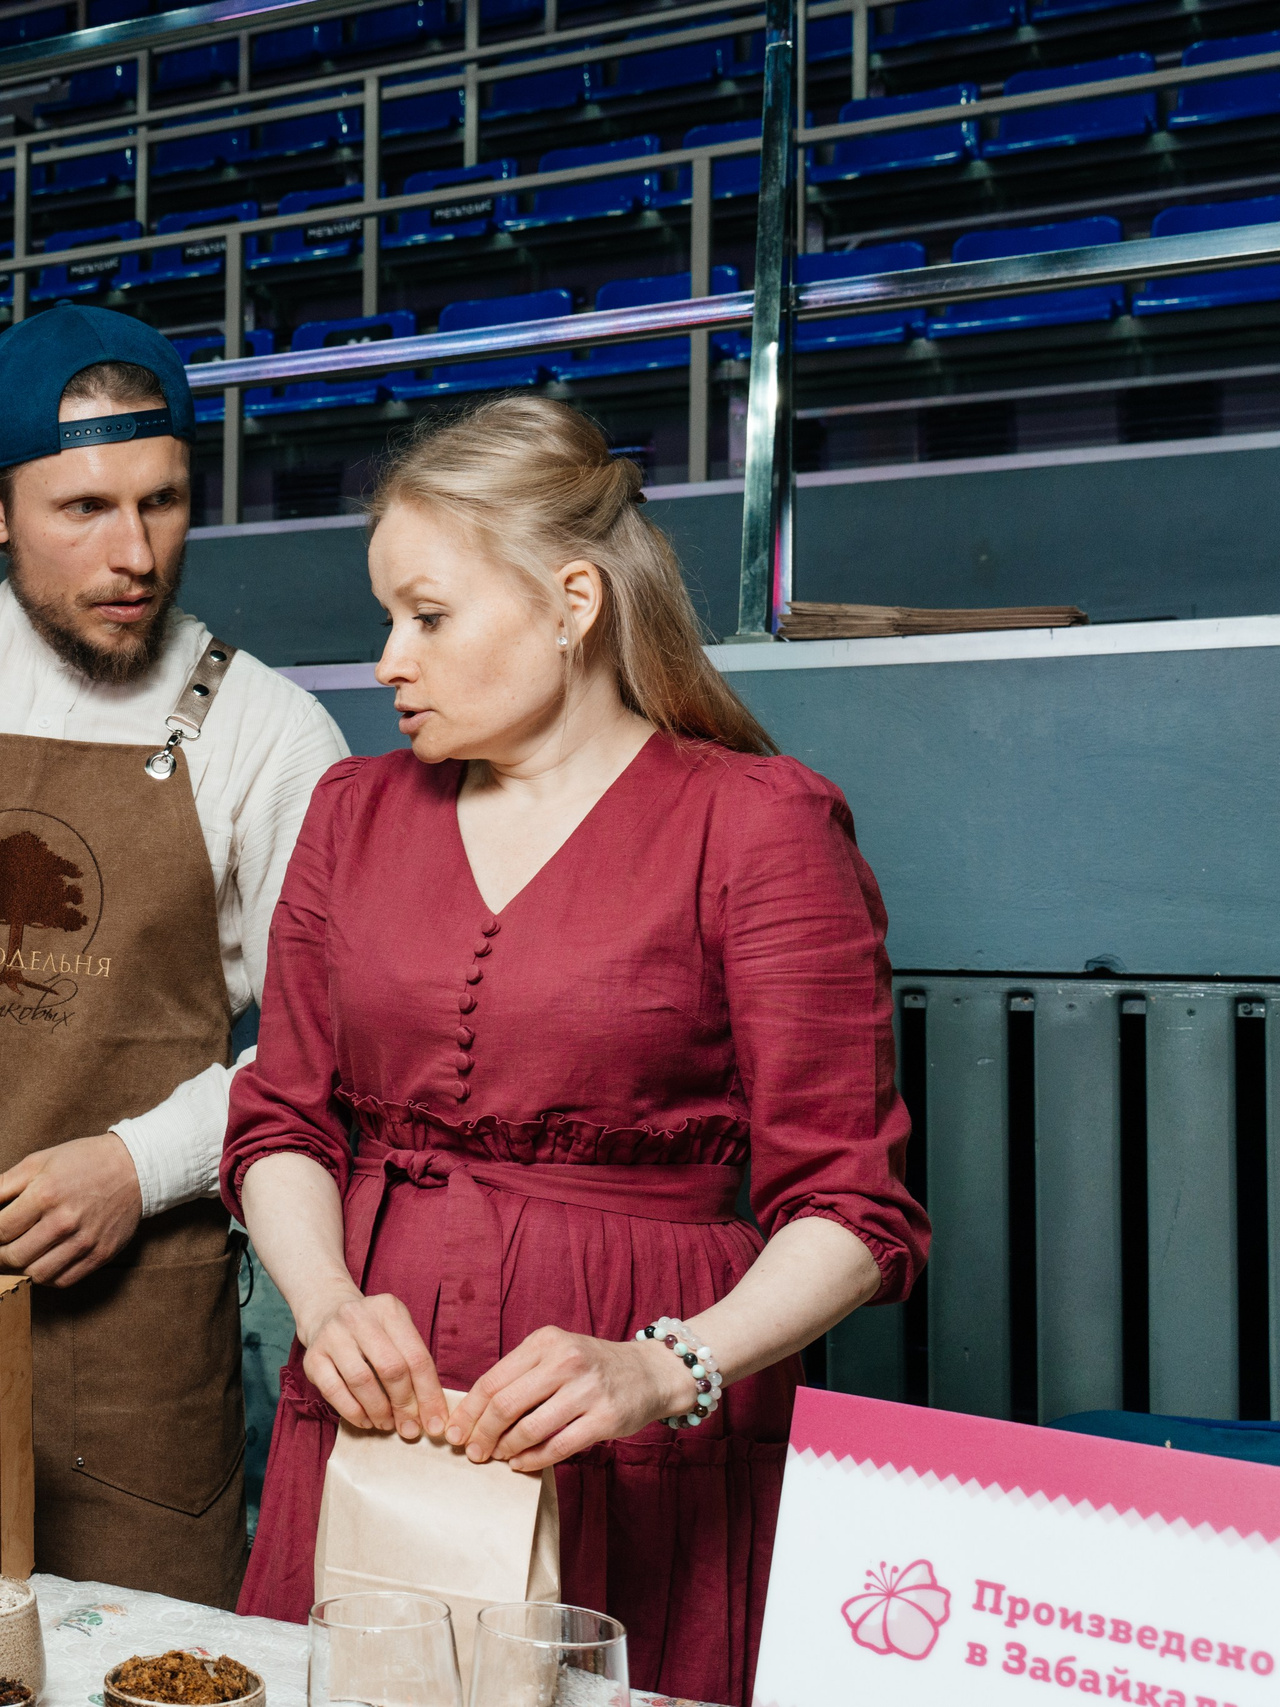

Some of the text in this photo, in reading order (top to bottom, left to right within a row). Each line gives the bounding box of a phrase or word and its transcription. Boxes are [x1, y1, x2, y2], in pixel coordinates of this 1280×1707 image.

[971, 1578, 1275, 1677] Произведено
[964, 1640, 1240, 1707] в Забайка
